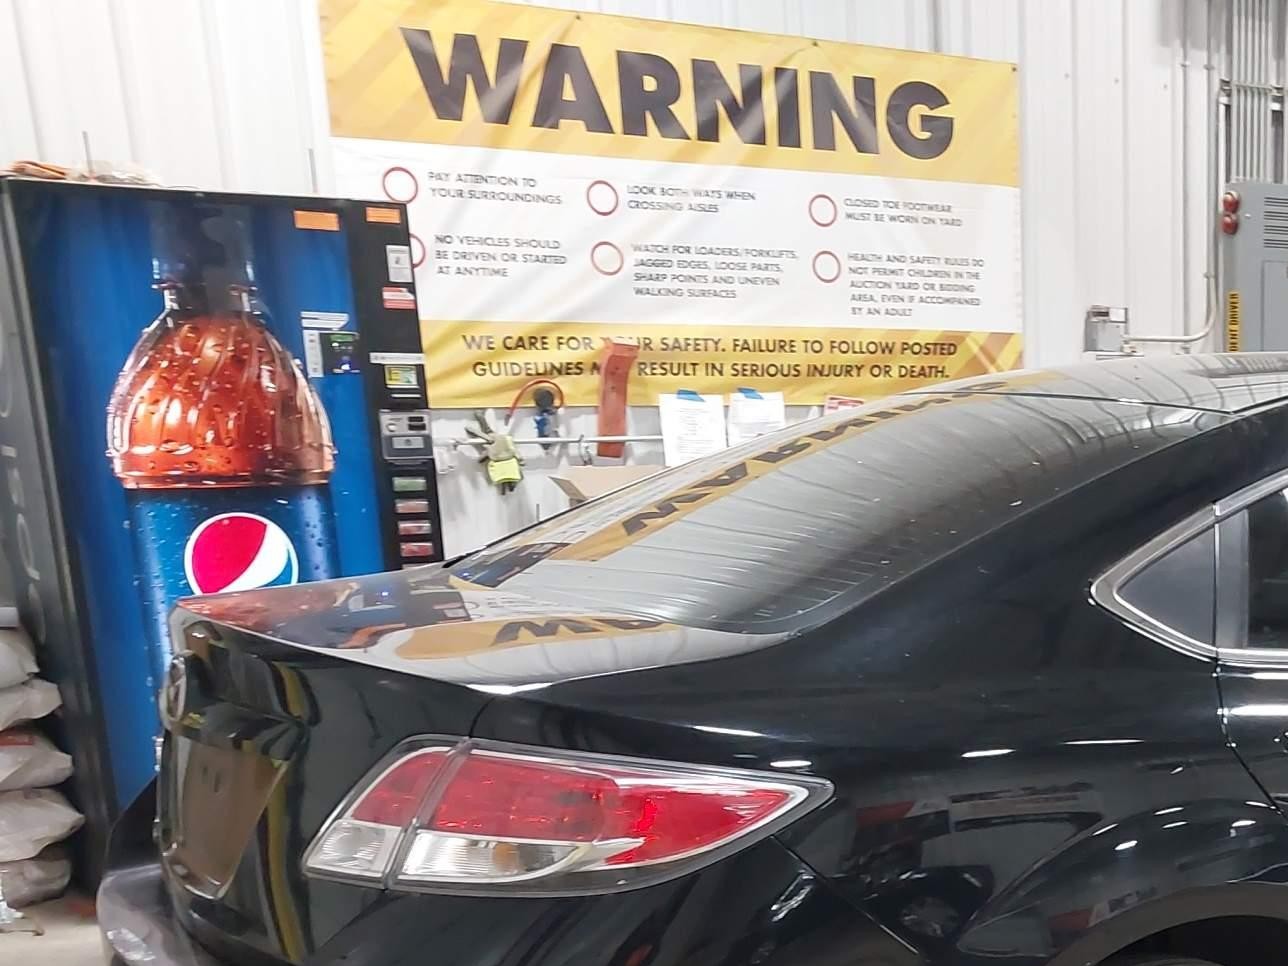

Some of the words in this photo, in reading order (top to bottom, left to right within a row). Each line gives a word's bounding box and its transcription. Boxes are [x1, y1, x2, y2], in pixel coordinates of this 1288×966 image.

[400, 27, 955, 159] WARNING
[428, 172, 450, 181] PAY
[456, 174, 518, 186] ATTENTION
[522, 178, 537, 187] TO
[430, 187, 464, 199] YOUR
[468, 189, 562, 204] SURROUNDINGS
[627, 185, 656, 196] LOOK
[661, 187, 689, 197] BOTH
[693, 188, 722, 199] WAYS
[726, 190, 756, 200] WHEN
[627, 200, 683, 211] CROSSING
[688, 203, 719, 213] AISLES
[844, 198, 880, 208] CLOSED
[883, 200, 900, 209] TOE
[903, 202, 952, 213] FOOTWEAR
[845, 212, 871, 220] MUST
[874, 213, 885, 222] BE
[888, 214, 919, 224] WORN
[922, 217, 936, 225] ON
[940, 218, 962, 226] YARD
[434, 234, 453, 244] NO
[458, 235, 510, 247] VEHICLES
[514, 238, 561, 249] SHOULD
[631, 243, 669, 253] WATCH
[672, 245, 691, 255] FOR
[435, 250, 449, 259] BE
[452, 251, 497, 262] DRIVEN
[501, 252, 518, 263] OR
[522, 254, 567, 265] STARTED
[633, 258, 673, 268] JAGGED
[677, 259, 712, 270] EDGES,
[715, 261, 747, 271] LOOSE
[848, 253, 883, 262] HEALTH
[886, 255, 906, 264] AND
[910, 256, 940, 265] SAFETY
[944, 257, 969, 266] RULES
[972, 258, 984, 267] DO
[437, 266, 450, 275] AT
[455, 266, 509, 277] ANYTIME
[848, 266, 868, 275] NOT
[872, 267, 904, 276] PERMIT
[908, 268, 951, 279] CHILDREN
[955, 270, 964, 279] IN
[966, 271, 980, 280] THE
[633, 273, 668, 282] SHARP
[671, 274, 708, 284] POINTS
[712, 275, 735, 285] AND
[738, 276, 780, 286] UNEVEN
[850, 280, 892, 289] AUCTION
[896, 281, 920, 290] YARD
[923, 282, 936, 291] OR
[939, 283, 975, 292] BIDDING
[633, 287, 683, 297] WALKING
[687, 288, 737, 298] SURFACES
[881, 294, 905, 303] EVEN
[908, 295, 915, 303] IF
[918, 296, 981, 306] ACCOMPANIED
[851, 307, 862, 315] BY
[867, 307, 881, 316] AN
[884, 308, 912, 316] ADULT
[462, 334, 495, 350] WE
[503, 335, 549, 351] CARE
[557, 336, 594, 350] FOR
[660, 336, 726, 352] SAFETY.
[732, 338, 797, 354] FAILURE
[803, 340, 823, 354] TO
[830, 340, 895, 355] FOLLOW
[900, 341, 957, 357] POSTED
[472, 361, 584, 377] GUIDELINES
[638, 362, 697, 377] RESULT
[705, 363, 724, 377] IN
[731, 363, 801, 377] SERIOUS
[807, 364, 865, 378] INJURY
[870, 364, 893, 378] OR
[899, 365, 950, 378] DEATH.
